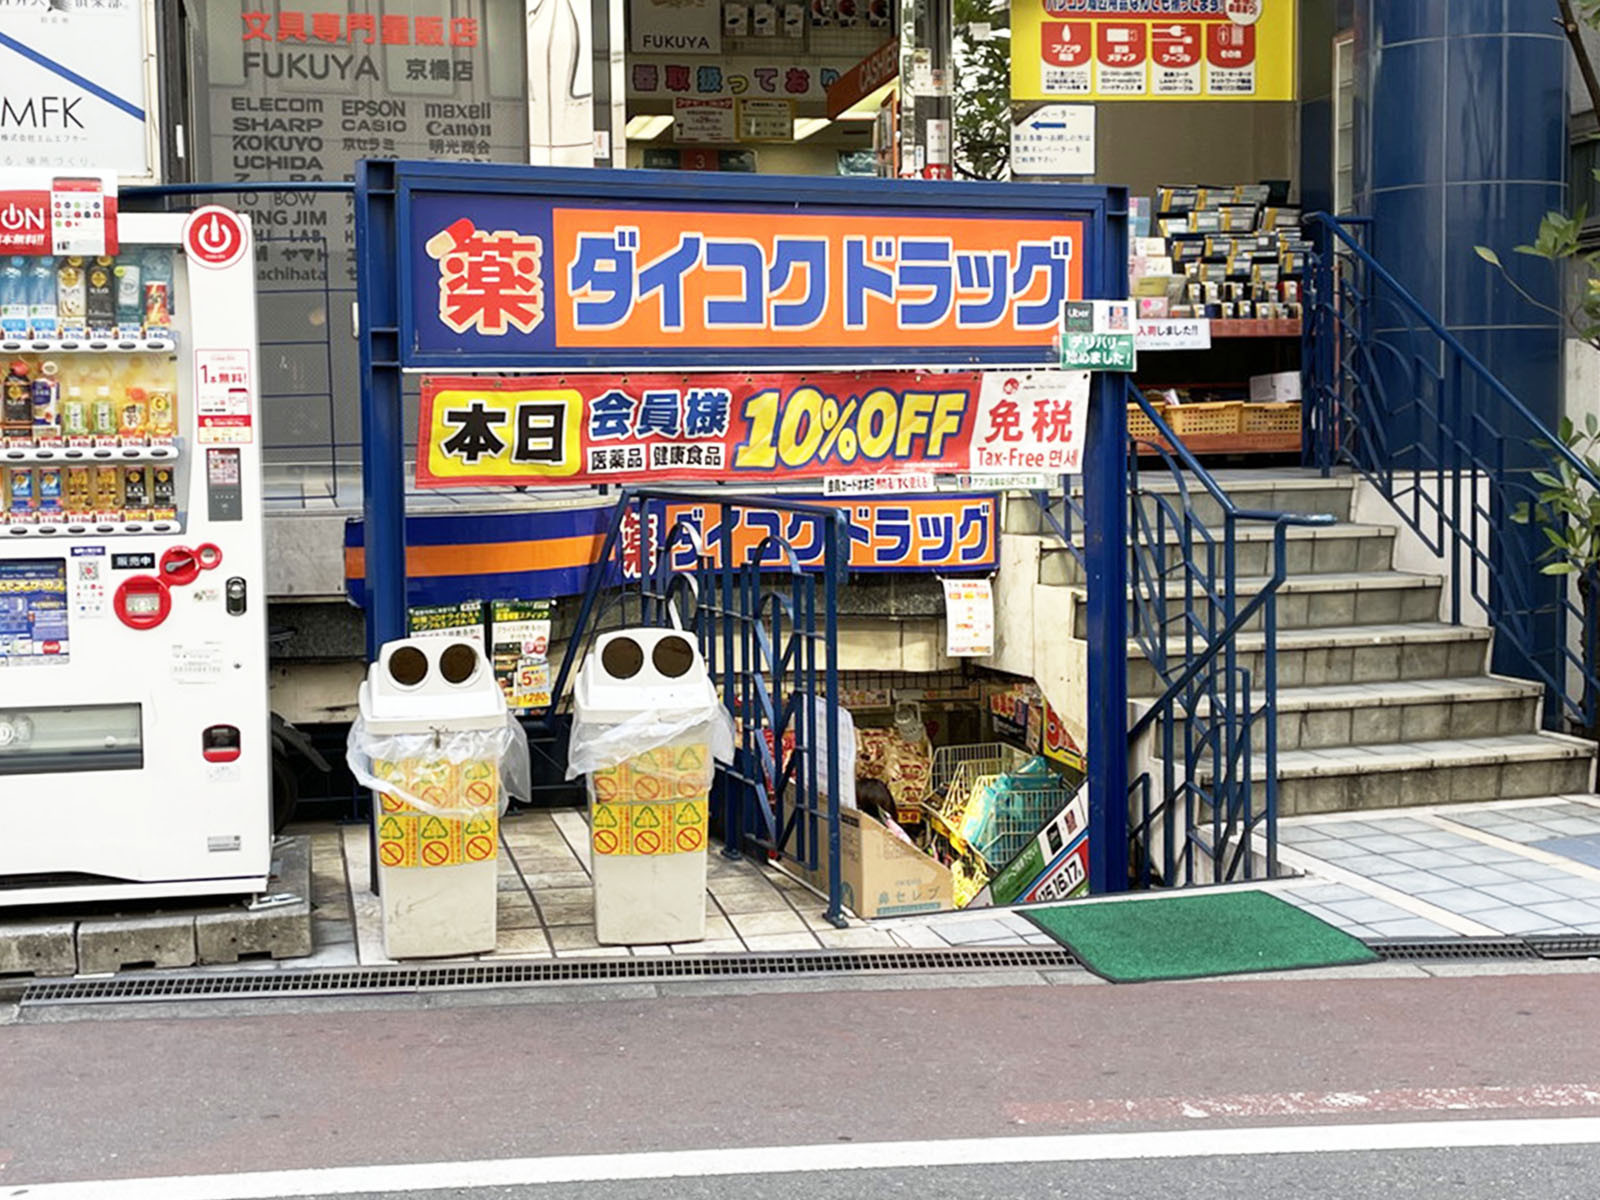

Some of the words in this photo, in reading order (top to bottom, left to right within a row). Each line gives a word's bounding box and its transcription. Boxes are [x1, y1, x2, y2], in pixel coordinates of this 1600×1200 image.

[241, 11, 477, 47] 文具専門量販店
[642, 34, 710, 49] FUKUYA
[243, 52, 379, 81] FUKUYA
[405, 59, 473, 81] 京橋店
[1, 96, 84, 129] MFK
[231, 97, 323, 112] ELECOM
[342, 100, 406, 117] EPSON
[424, 102, 491, 119] maxell
[232, 117, 323, 132] SHARP
[341, 119, 406, 132] CASIO
[426, 120, 491, 136] Canon
[232, 135, 323, 151] KOKUYO
[233, 155, 323, 170] UCHIDA
[292, 210, 327, 226] JIM
[566, 226, 1071, 334] ダイコクドラッグ
[1067, 308, 1090, 317] Uber
[443, 402, 567, 463] 本日
[589, 390, 731, 438] 会員様
[734, 385, 970, 470] 10%OFF
[984, 399, 1073, 443] 免税
[591, 448, 643, 471] 医薬品
[653, 442, 722, 467] 健康食品
[977, 446, 1044, 467] Tax-Free
[117, 556, 151, 567] 販売中
